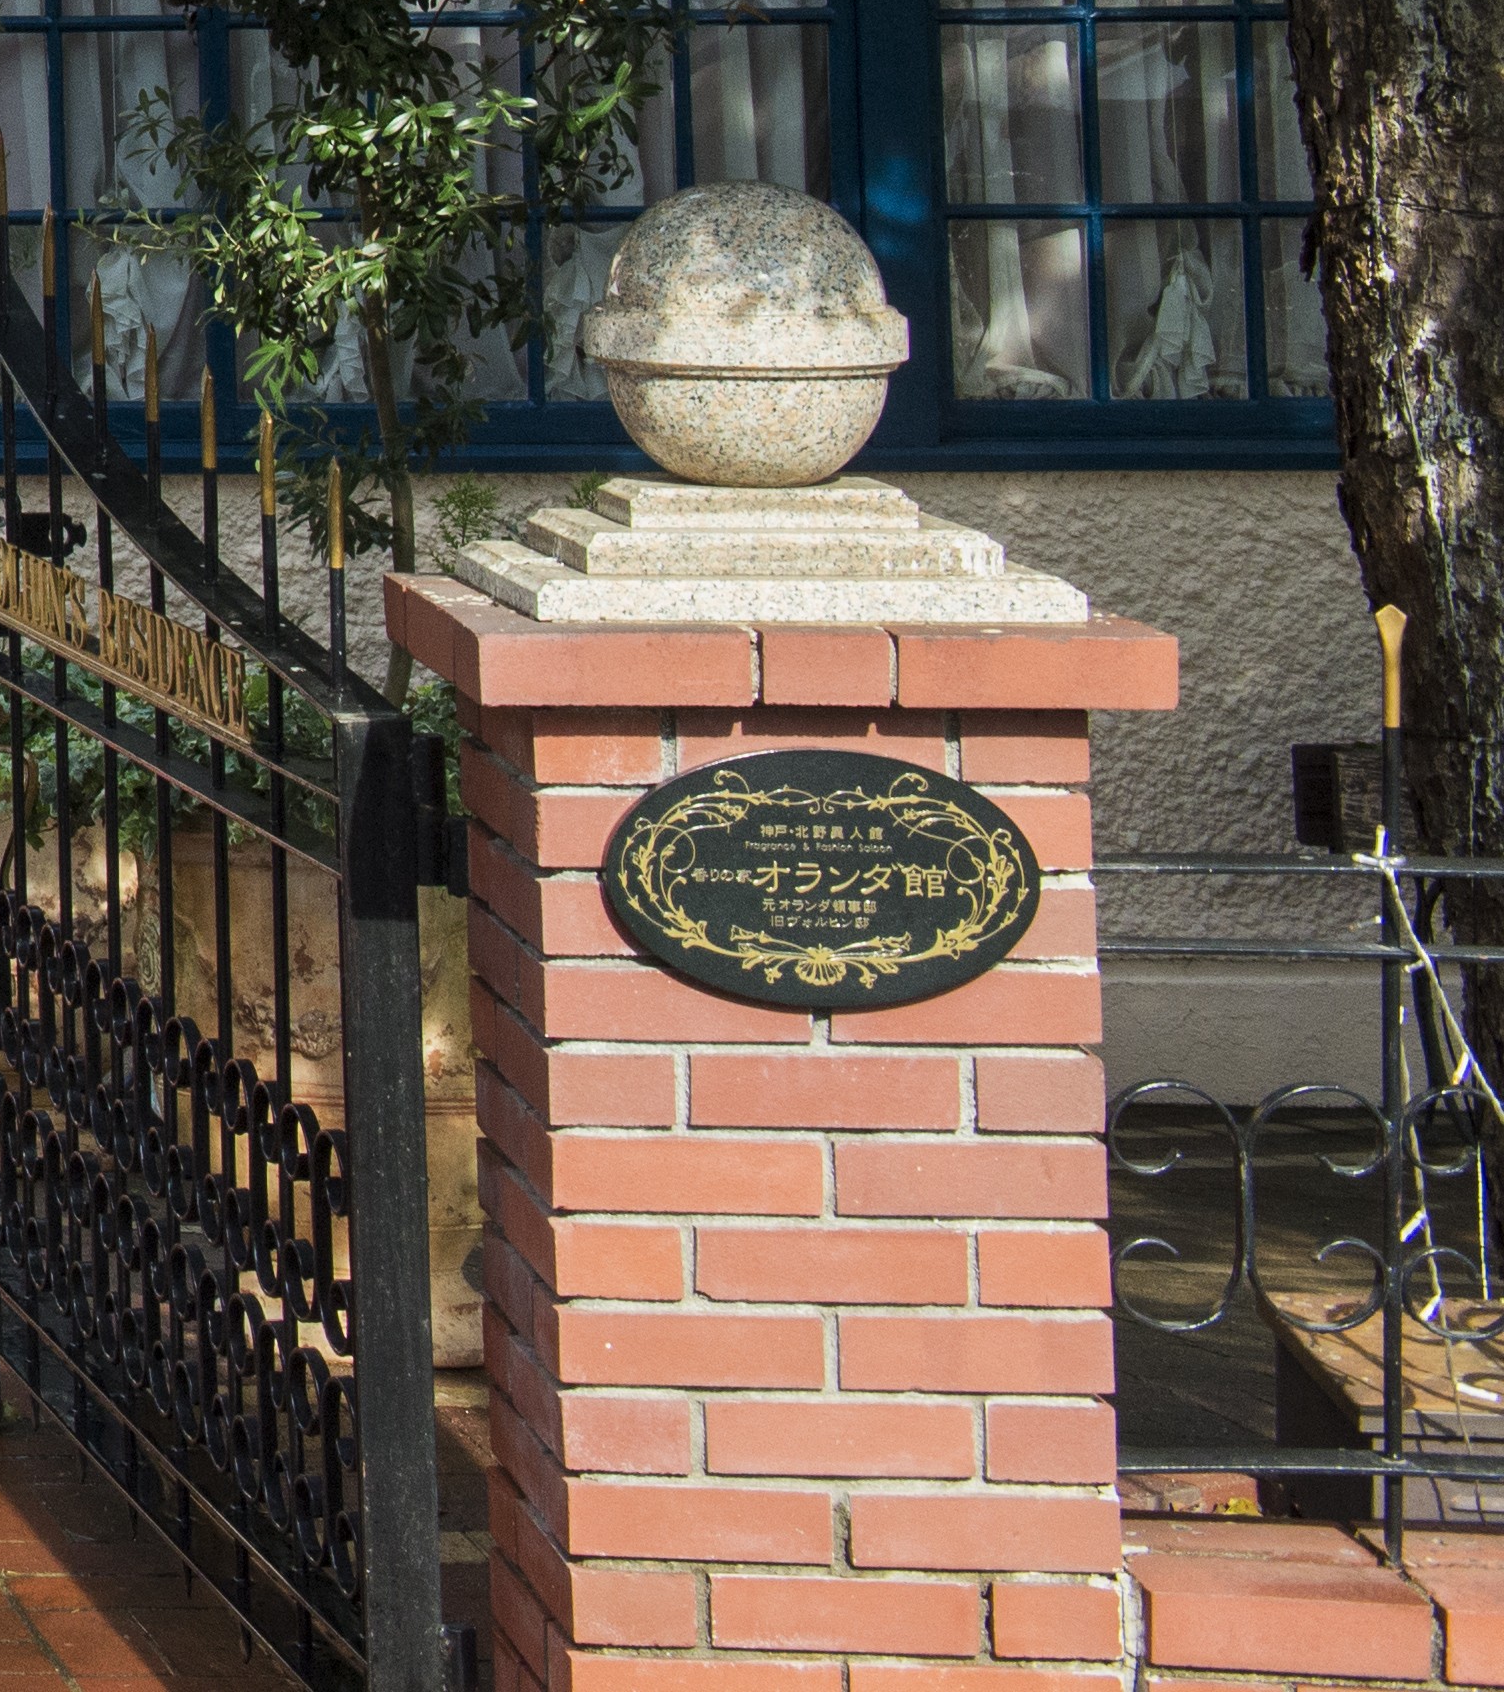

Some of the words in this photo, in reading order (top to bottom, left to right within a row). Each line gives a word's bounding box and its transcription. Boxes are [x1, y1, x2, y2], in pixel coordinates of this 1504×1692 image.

[98, 586, 252, 741] RESIDENCE
[745, 840, 796, 852] Fragrance
[802, 841, 810, 851] &
[815, 841, 854, 852] Fashion
[752, 860, 948, 898] オランダ館
